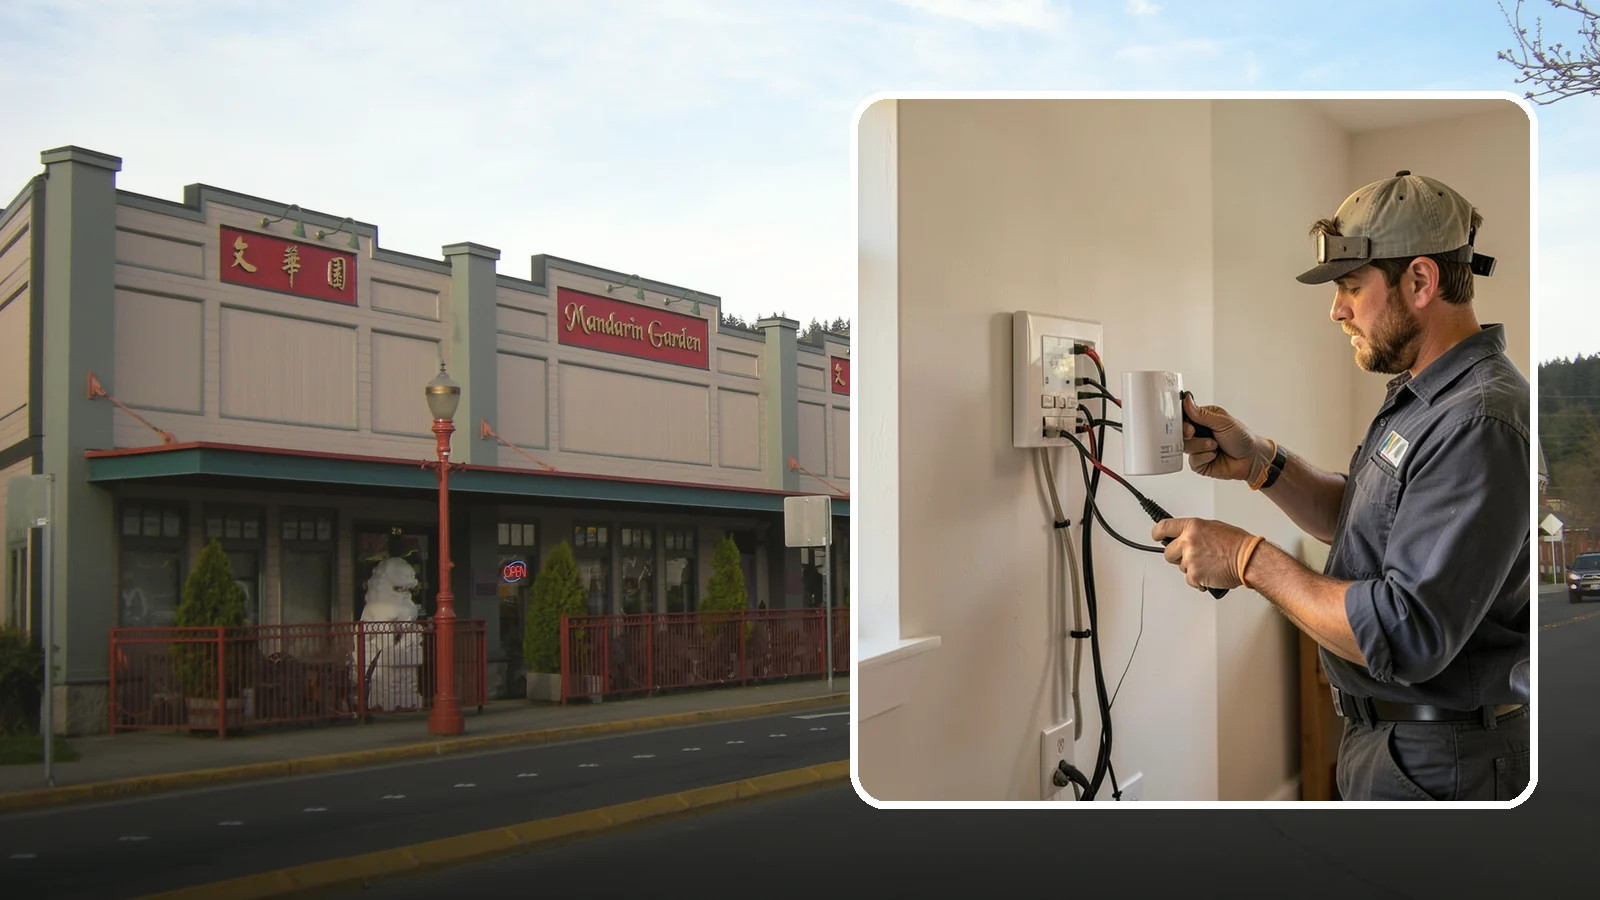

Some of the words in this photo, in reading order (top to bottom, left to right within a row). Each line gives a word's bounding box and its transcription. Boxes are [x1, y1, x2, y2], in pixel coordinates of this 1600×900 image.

[231, 236, 346, 291] 文華園
[565, 303, 643, 340] Mandarin
[648, 320, 701, 352] Garden
[503, 565, 527, 578] OPEN
